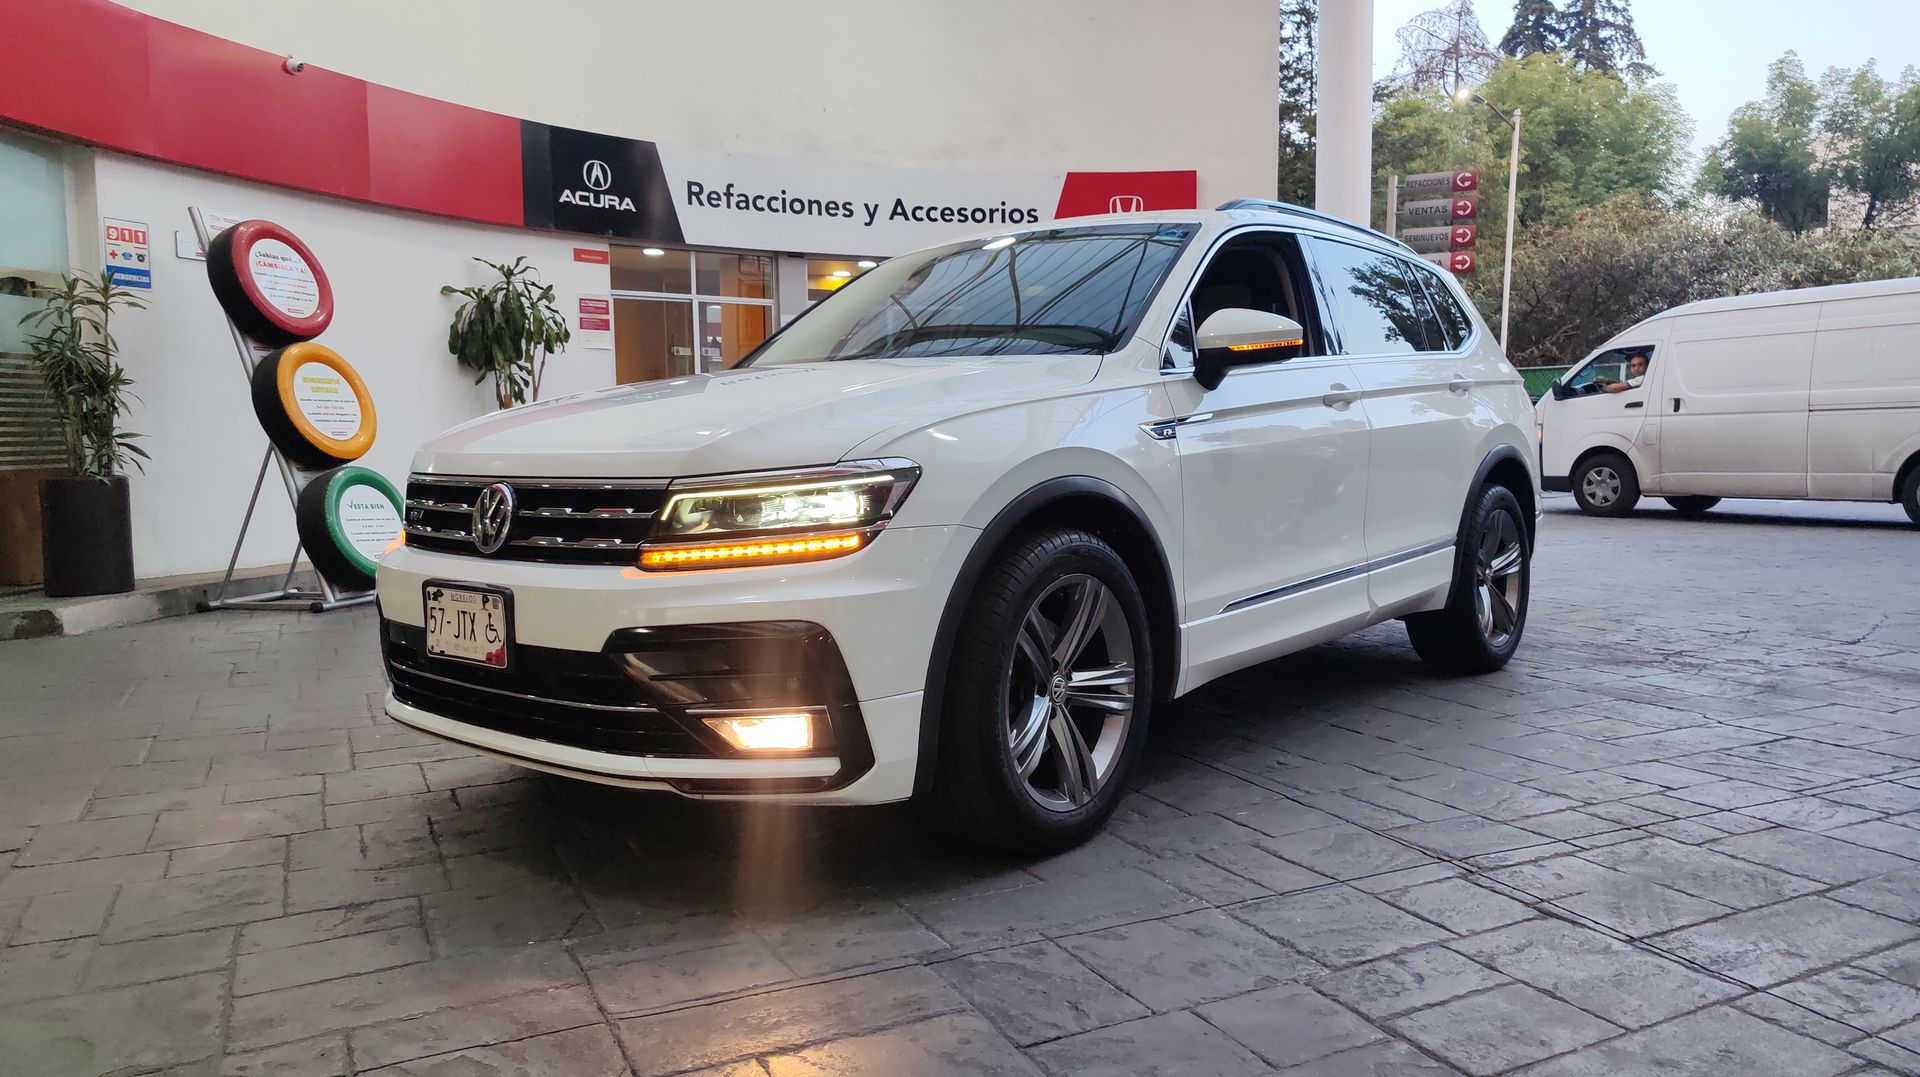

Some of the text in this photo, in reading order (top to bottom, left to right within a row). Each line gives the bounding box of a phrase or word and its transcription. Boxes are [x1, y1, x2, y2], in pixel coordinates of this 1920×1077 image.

[1406, 176, 1451, 188] REFACCIONES
[559, 189, 637, 213] ACURA
[686, 180, 1040, 227] Refacciones y Accesorios
[1408, 205, 1448, 216] VENTAS
[108, 226, 145, 244] 911
[1404, 232, 1449, 242] SEMINUEVOS
